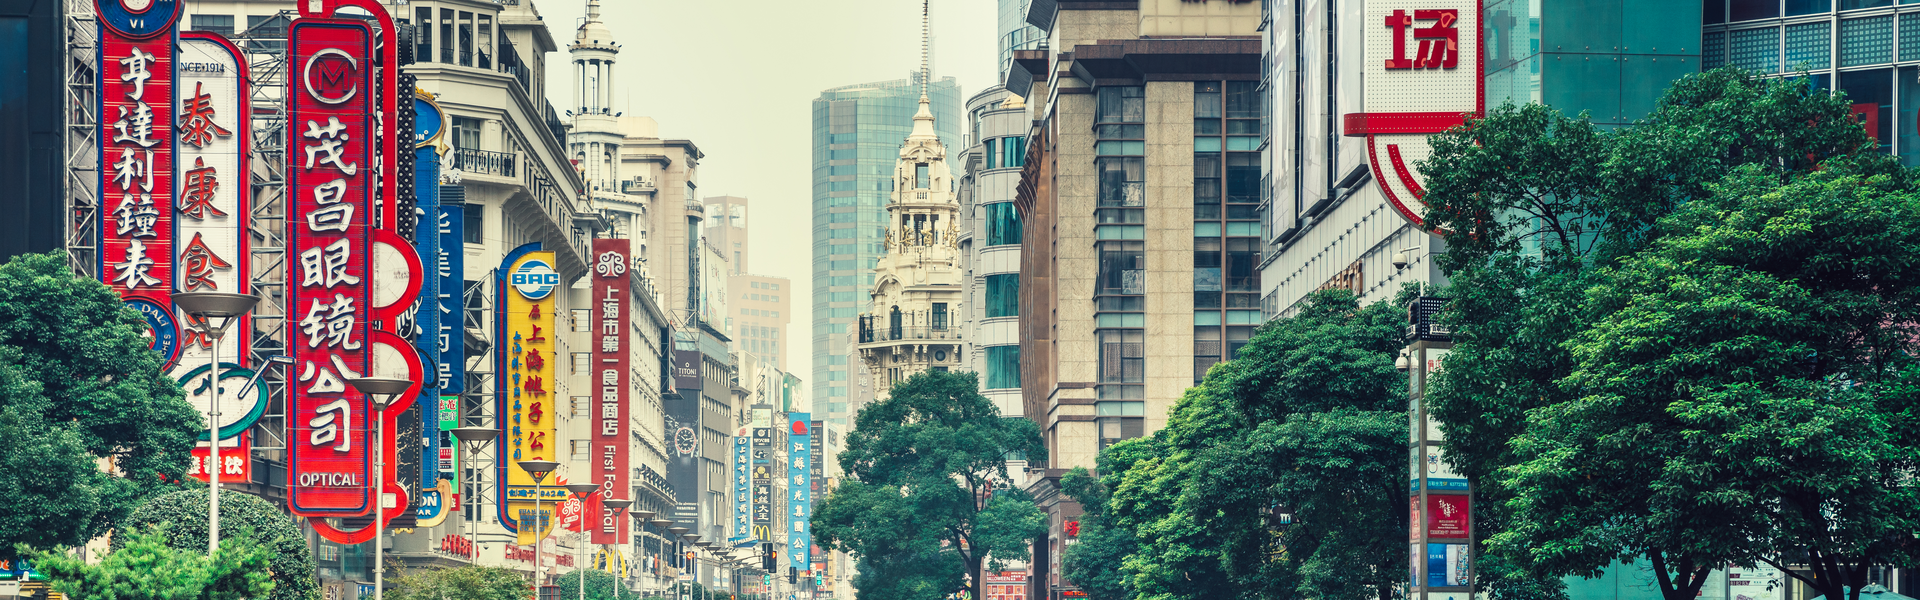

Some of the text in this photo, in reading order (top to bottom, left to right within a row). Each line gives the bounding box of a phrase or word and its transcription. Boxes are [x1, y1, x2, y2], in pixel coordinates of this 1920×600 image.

[1385, 10, 1458, 69] 场
[300, 116, 362, 452] 茂昌眼镜公司
[512, 273, 559, 285] BAC
[162, 333, 171, 356] CHES
[602, 286, 619, 436] 上海市第一食品商店
[300, 472, 360, 487] OPTICAL
[508, 489, 566, 498] 创建于942年
[604, 445, 616, 533] First Foohall
